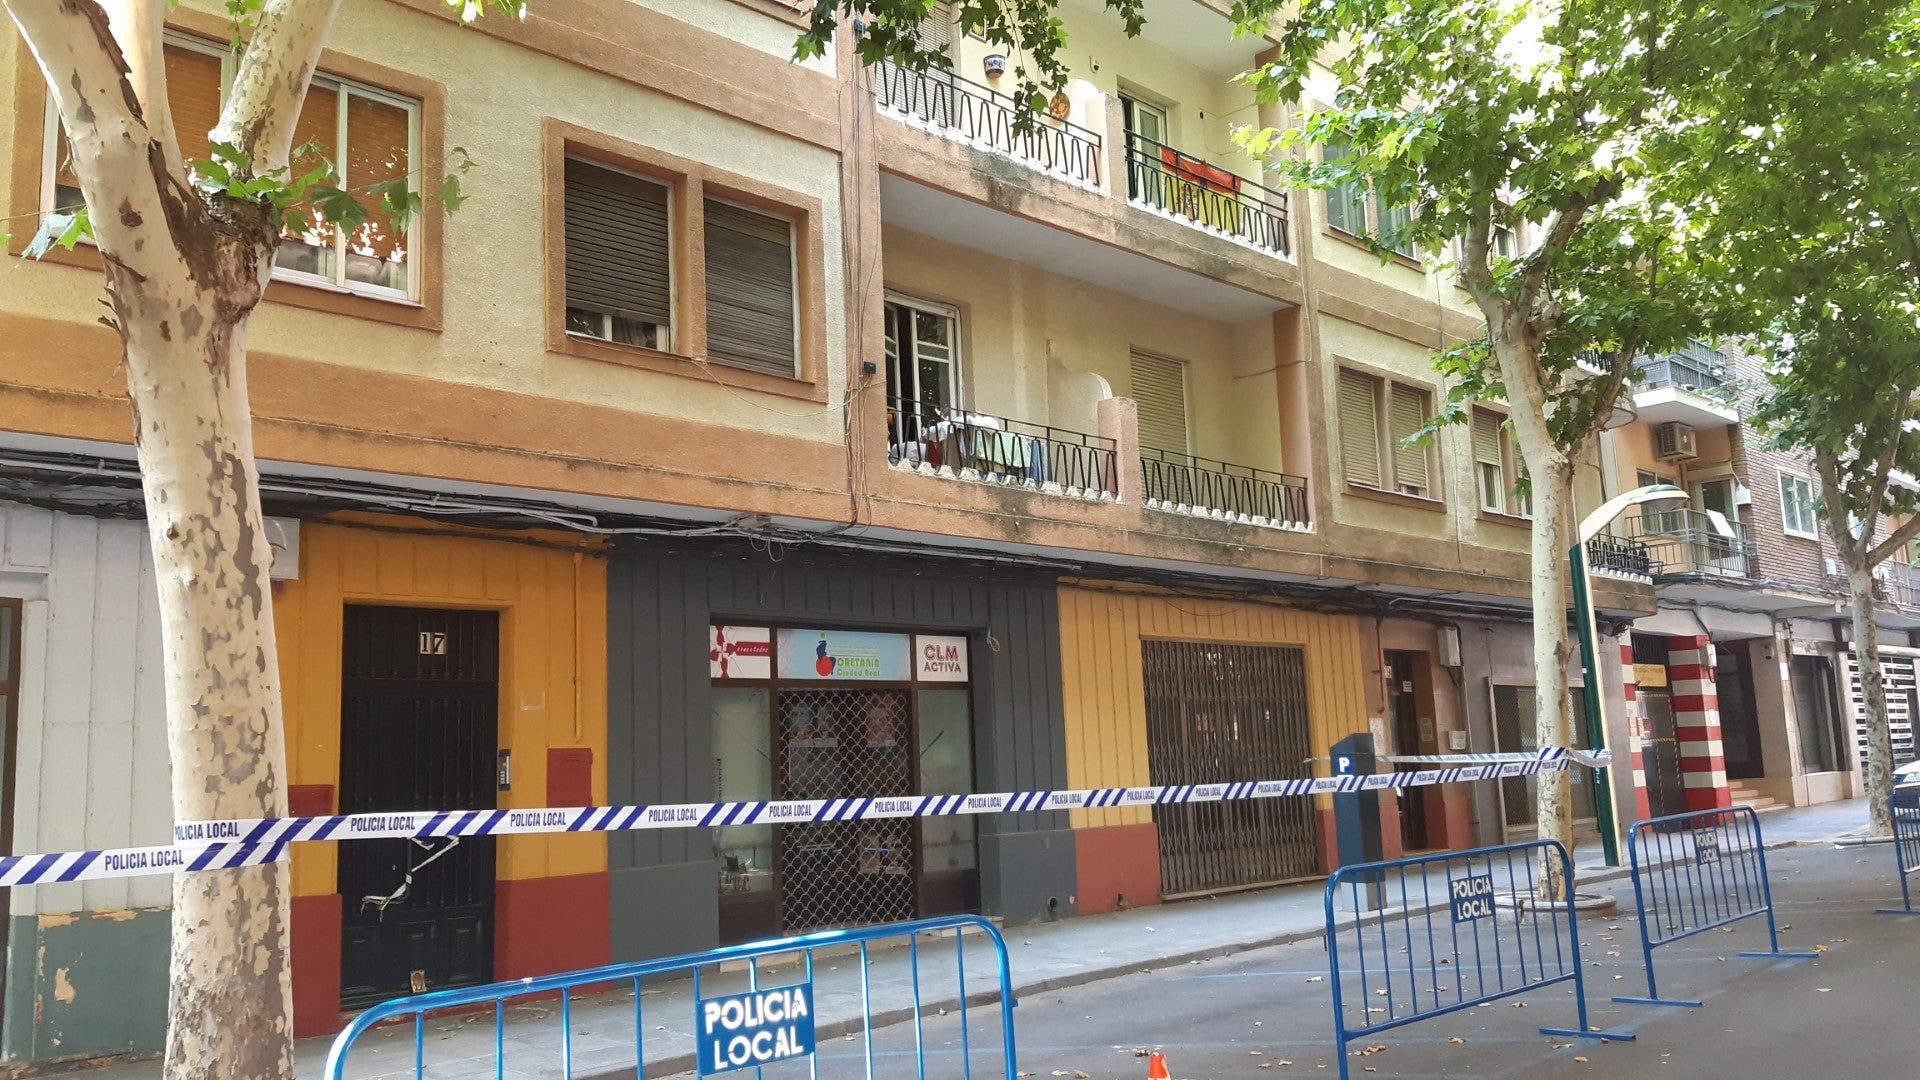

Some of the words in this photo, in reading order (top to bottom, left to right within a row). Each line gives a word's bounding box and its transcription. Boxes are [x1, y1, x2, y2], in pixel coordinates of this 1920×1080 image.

[421, 633, 446, 653] 17
[924, 644, 959, 661] CLM
[837, 657, 880, 668] ORETANIA
[924, 662, 961, 672] ACTIVA
[865, 669, 880, 677] Real
[1338, 757, 1350, 773] P
[968, 798, 986, 809] POLICIA
[987, 797, 1002, 808] LOCAL
[1051, 794, 1068, 805] POLICIA
[1069, 793, 1082, 804] LOCAL
[1126, 791, 1142, 801] POLICIA
[1143, 789, 1155, 800] LOCAL
[768, 805, 792, 818] POLICIA
[793, 804, 812, 816] LOCAL
[874, 801, 895, 813] POLICIA
[896, 800, 912, 812] LOCAL
[510, 812, 541, 827] POLICIA
[542, 811, 567, 826] LOCAL
[648, 809, 675, 822] POLICIA
[676, 808, 698, 821] LOCAL
[174, 823, 204, 841] POLICIA
[206, 822, 240, 839] LOCAL
[350, 817, 386, 832] POLICIA
[388, 816, 416, 831] LOCAL
[105, 853, 148, 871] POLICIA
[150, 849, 184, 868] LOCAL
[1452, 876, 1492, 899] POLICIA
[1457, 898, 1492, 920] LOCAL
[704, 988, 808, 1034] POLICIA
[713, 1025, 804, 1070] LOCAL
